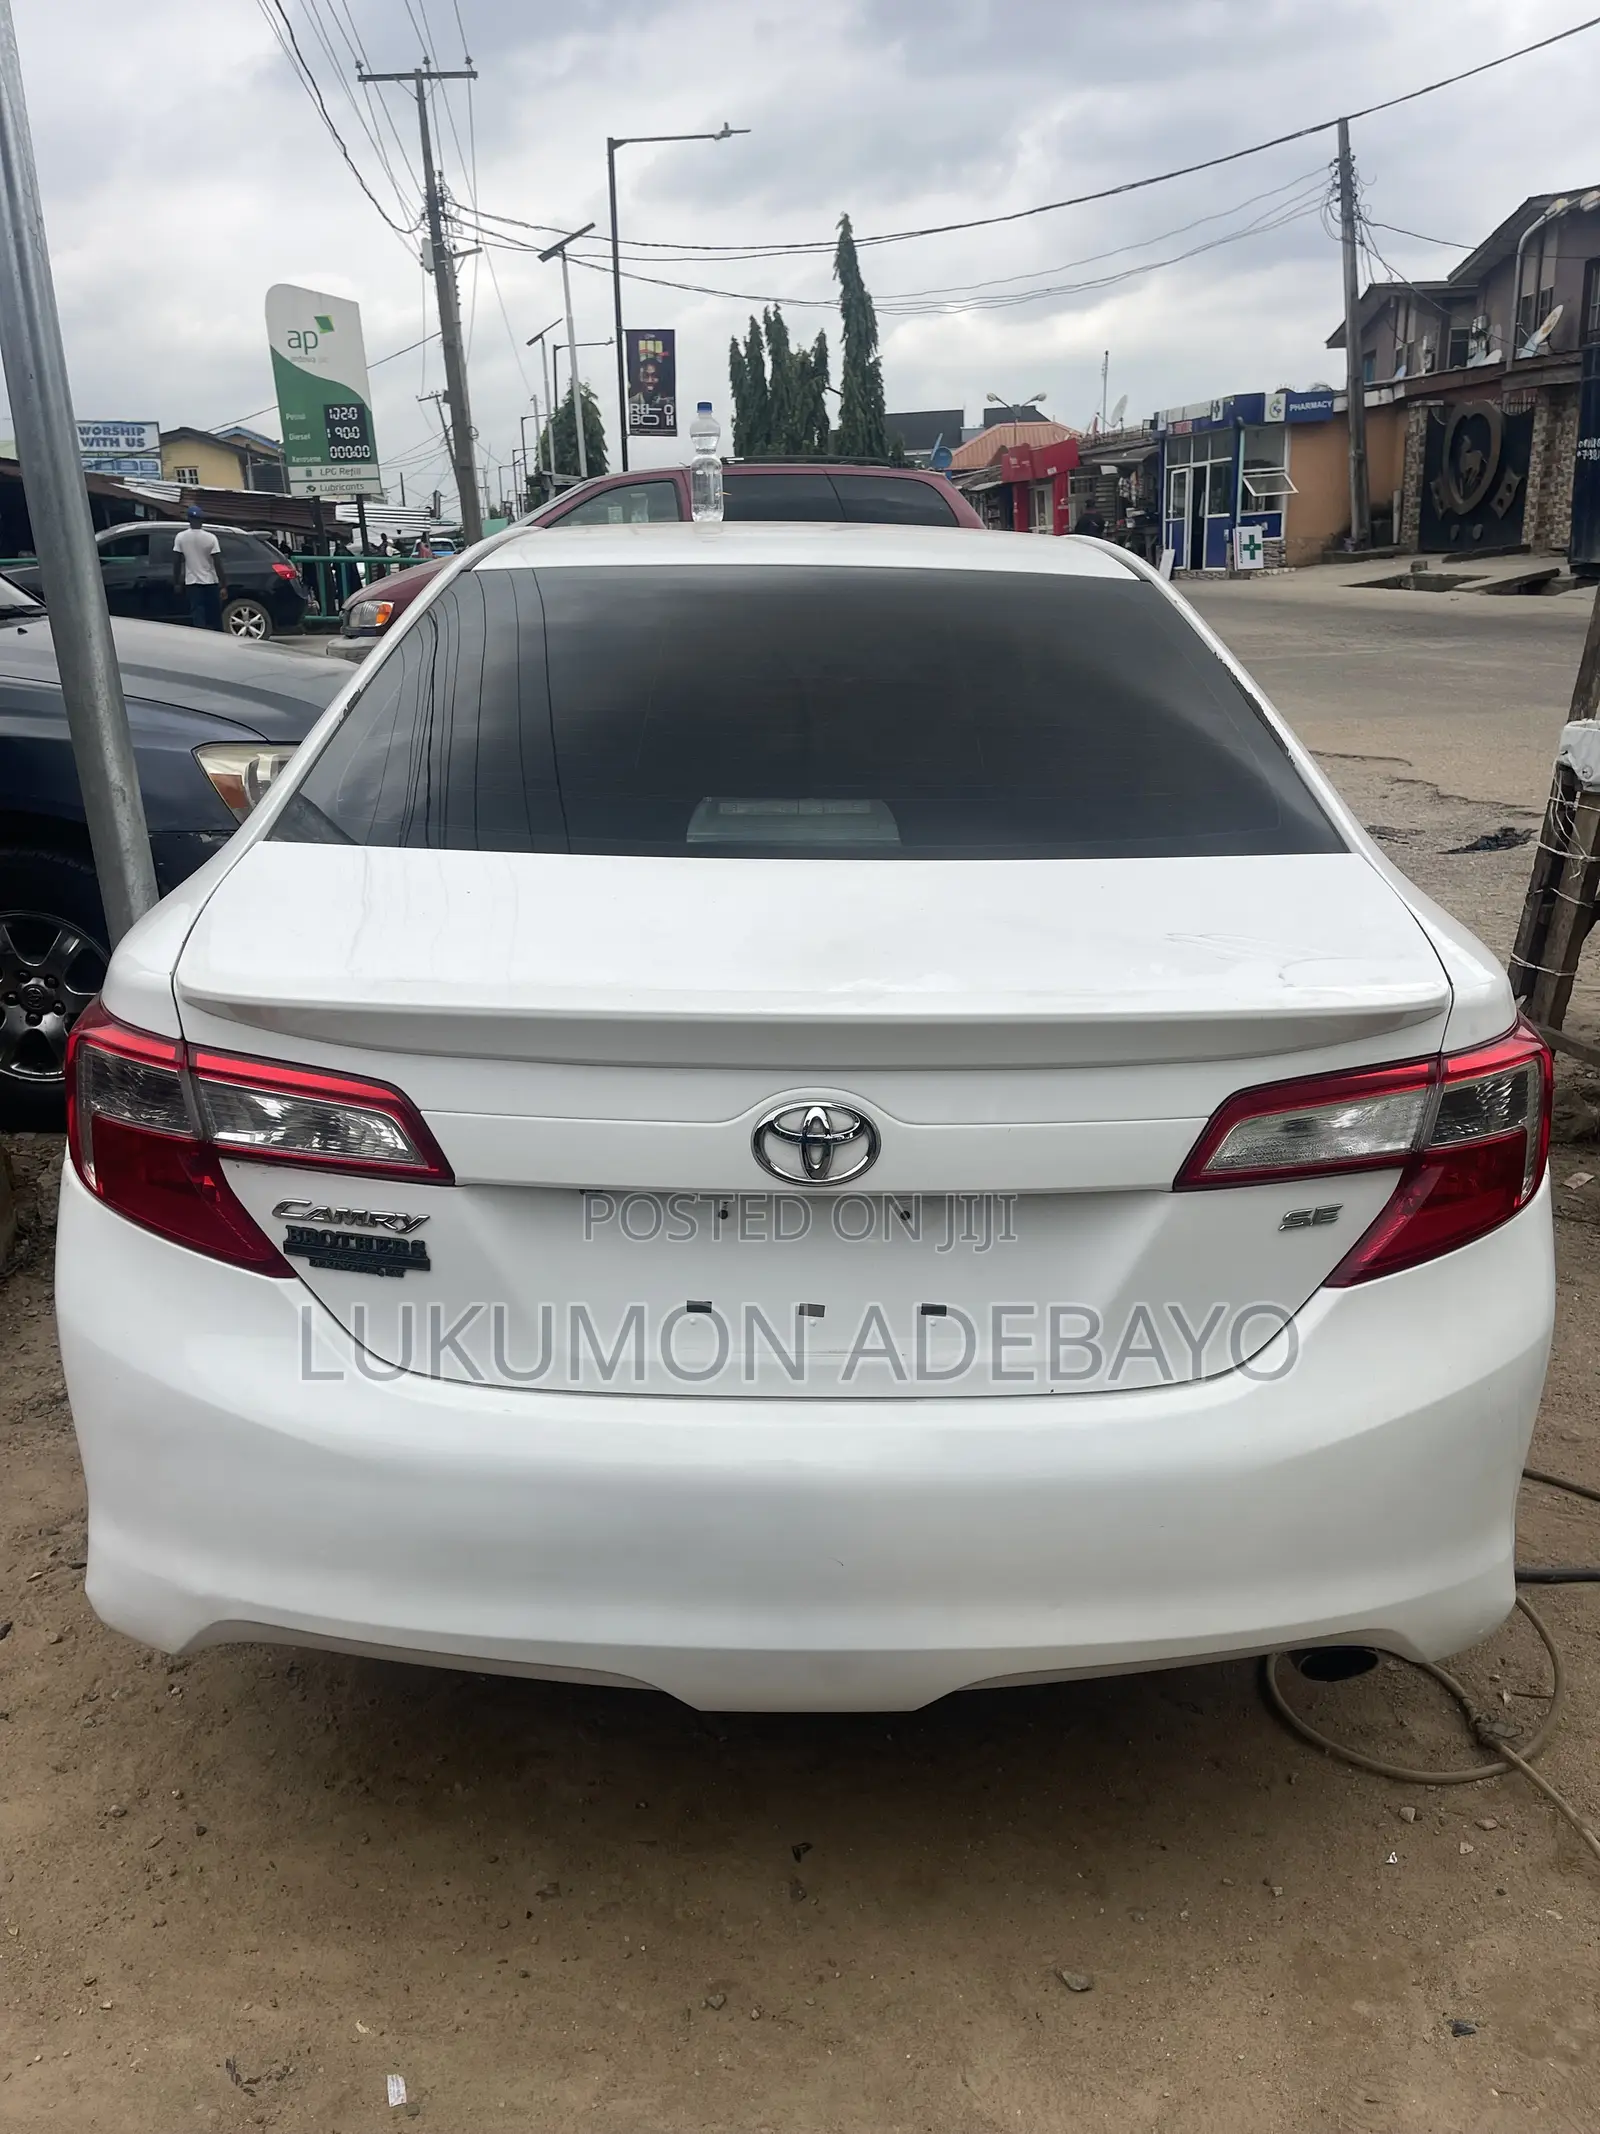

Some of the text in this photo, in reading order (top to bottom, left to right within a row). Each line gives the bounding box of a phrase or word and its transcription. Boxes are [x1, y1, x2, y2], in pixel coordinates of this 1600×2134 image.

[287, 330, 318, 355] ap
[1289, 401, 1332, 411] PHARMACY
[78, 426, 146, 436] WORSHIP
[80, 437, 146, 448] WITH US
[320, 467, 361, 476] LPG Refill
[320, 483, 364, 492] Lubricants
[272, 1198, 430, 1234] CAMRY
[1279, 1203, 1343, 1230] SE
[285, 1225, 426, 1259] BROTHERS
